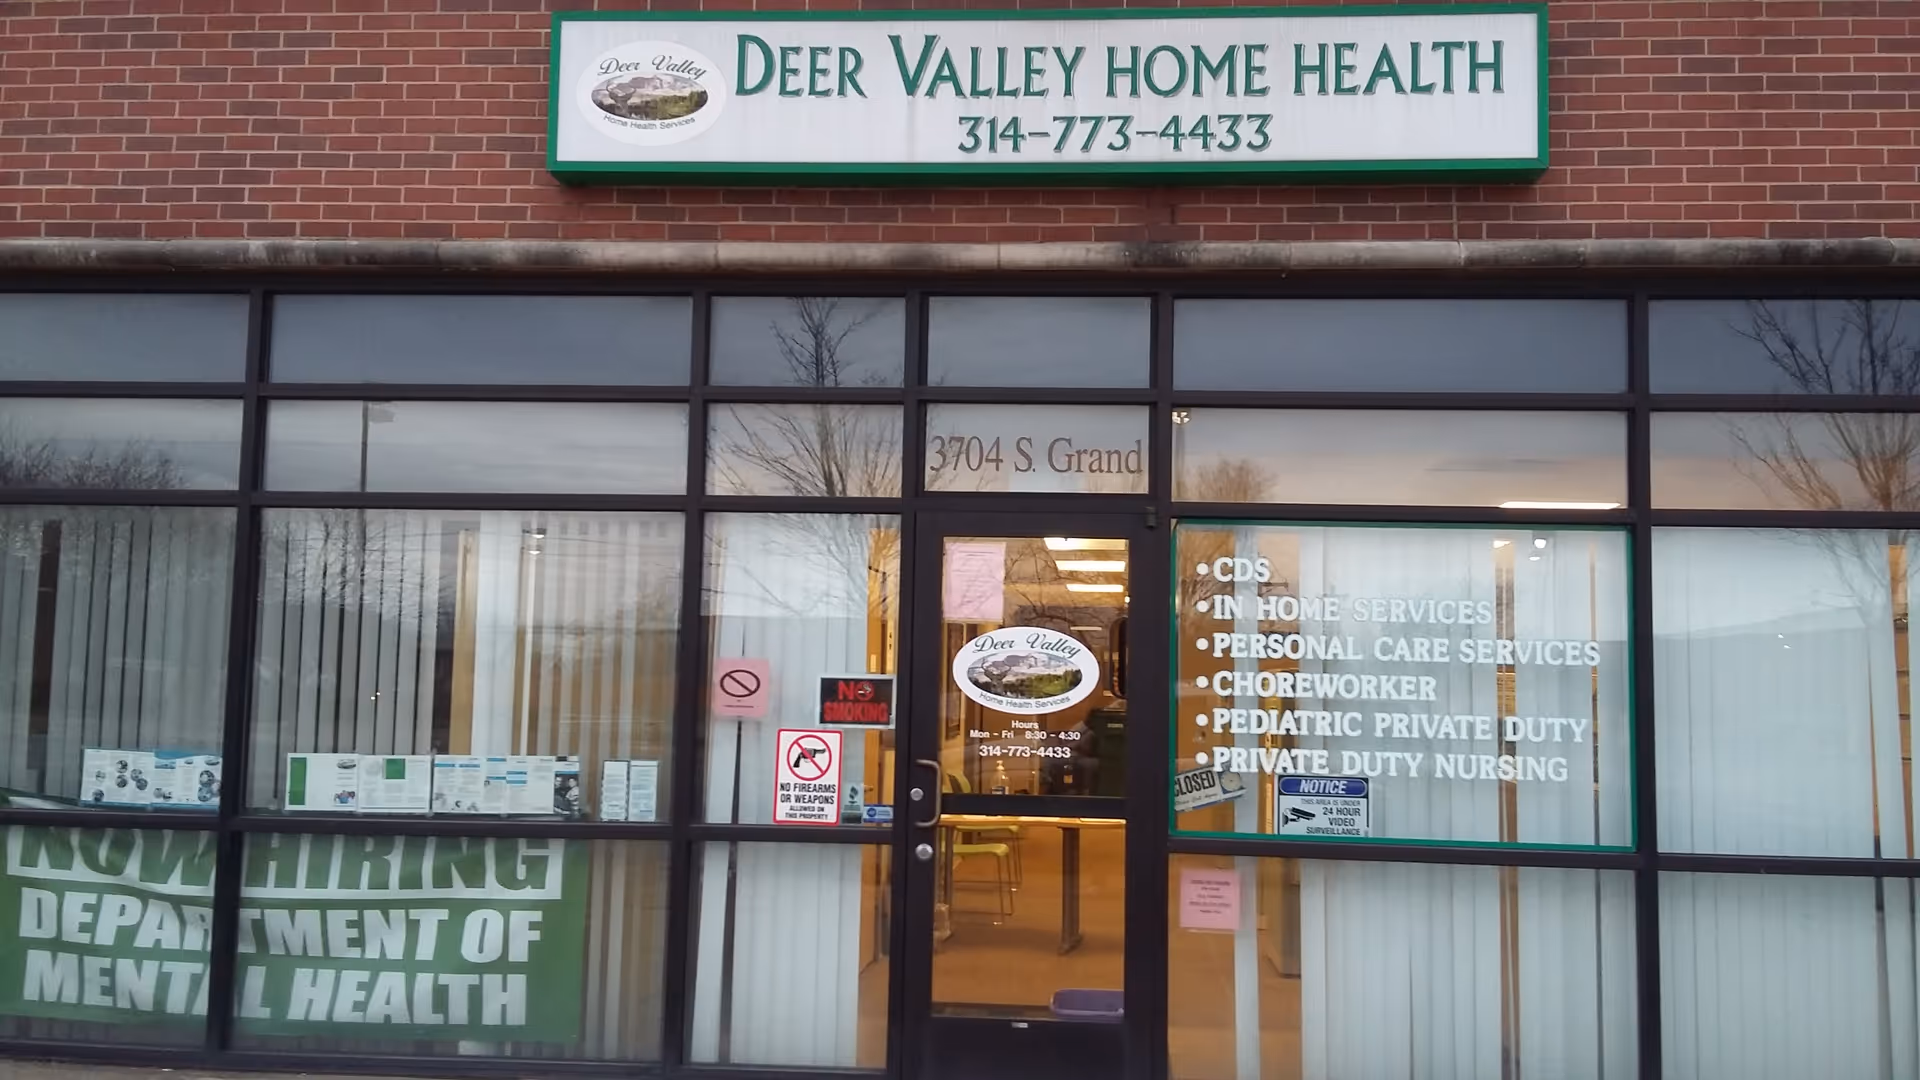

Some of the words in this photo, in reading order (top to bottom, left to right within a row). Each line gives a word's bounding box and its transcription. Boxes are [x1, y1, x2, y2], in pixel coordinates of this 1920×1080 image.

[597, 57, 640, 76] Deer
[651, 55, 707, 80] Valley
[736, 34, 867, 99] DEER
[888, 34, 1086, 99] VALLEY
[1106, 43, 1271, 98] HOME
[1293, 40, 1504, 96] HEALTH
[603, 114, 628, 128] Home
[630, 121, 657, 130] Health
[659, 116, 696, 130] Services
[957, 113, 1273, 154] 314-773-4433
[929, 435, 1003, 472] 3704
[1014, 436, 1036, 473] S.
[1047, 437, 1143, 475] Grand
[1212, 557, 1271, 583] CDS
[1212, 595, 1243, 620] IN
[1256, 596, 1341, 622] HOME
[1353, 599, 1493, 626] SERVICES
[972, 635, 1015, 653] Deer
[1026, 632, 1081, 659] Valley
[1212, 632, 1363, 661] PERSONAL
[1373, 635, 1450, 663] CARE
[1459, 639, 1601, 667] SERVICES
[1212, 670, 1437, 701] CHOREWORKER
[823, 701, 889, 723] SMOKING
[980, 691, 1004, 706] Home
[1005, 699, 1033, 709] Health
[1034, 695, 1071, 709] Services
[970, 729, 990, 738] Mon
[1002, 730, 1014, 739] Fri
[1025, 730, 1047, 739] 8:30
[1058, 731, 1081, 740] 4:30
[1011, 720, 1039, 729] Hours
[1212, 707, 1363, 737] PEDIATRIC
[1374, 712, 1493, 740] PRIVATE
[1504, 716, 1588, 744] DUTY
[979, 745, 1071, 758] 314-773-4433
[1212, 746, 1330, 776] PRIVATE
[1342, 750, 1424, 778] DUTY
[1435, 754, 1568, 782] NURSING
[780, 783, 791, 792] NO
[793, 783, 837, 793] FIREARMS
[781, 794, 792, 803] OR
[794, 794, 835, 804] WEAPONS
[1299, 779, 1348, 794] NOTICE
[1322, 807, 1334, 816] 24
[1336, 807, 1361, 816] HOUR
[1328, 817, 1356, 827] VIDEO
[1306, 826, 1361, 836] SURVEILLANCE
[18, 824, 218, 889] NOW
[244, 830, 550, 892] HIRING
[19, 886, 449, 960] DEPARTMENT
[460, 909, 544, 964] OF
[286, 967, 527, 1026] HEALTH
